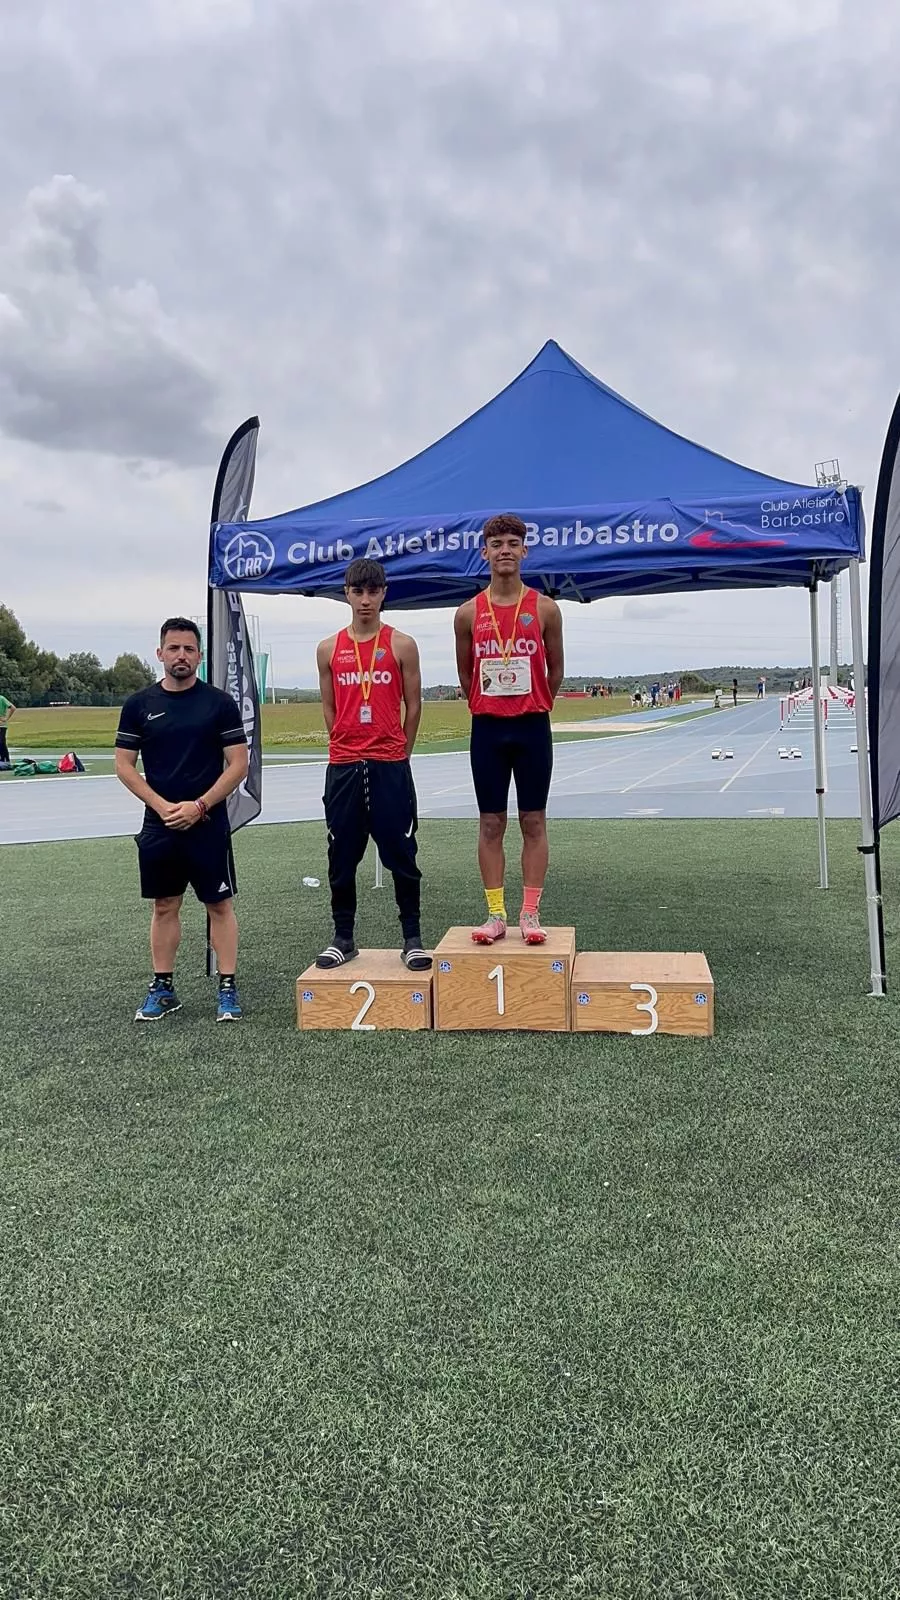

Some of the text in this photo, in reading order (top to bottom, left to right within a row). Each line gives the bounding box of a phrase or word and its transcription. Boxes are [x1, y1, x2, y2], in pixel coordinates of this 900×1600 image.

[761, 500, 789, 512] Club
[761, 510, 845, 528] Barbastro
[288, 519, 679, 564] Club Atletism Barbastro
[349, 981, 377, 1030] 2
[487, 964, 504, 1015] 1
[630, 983, 659, 1036] 3
